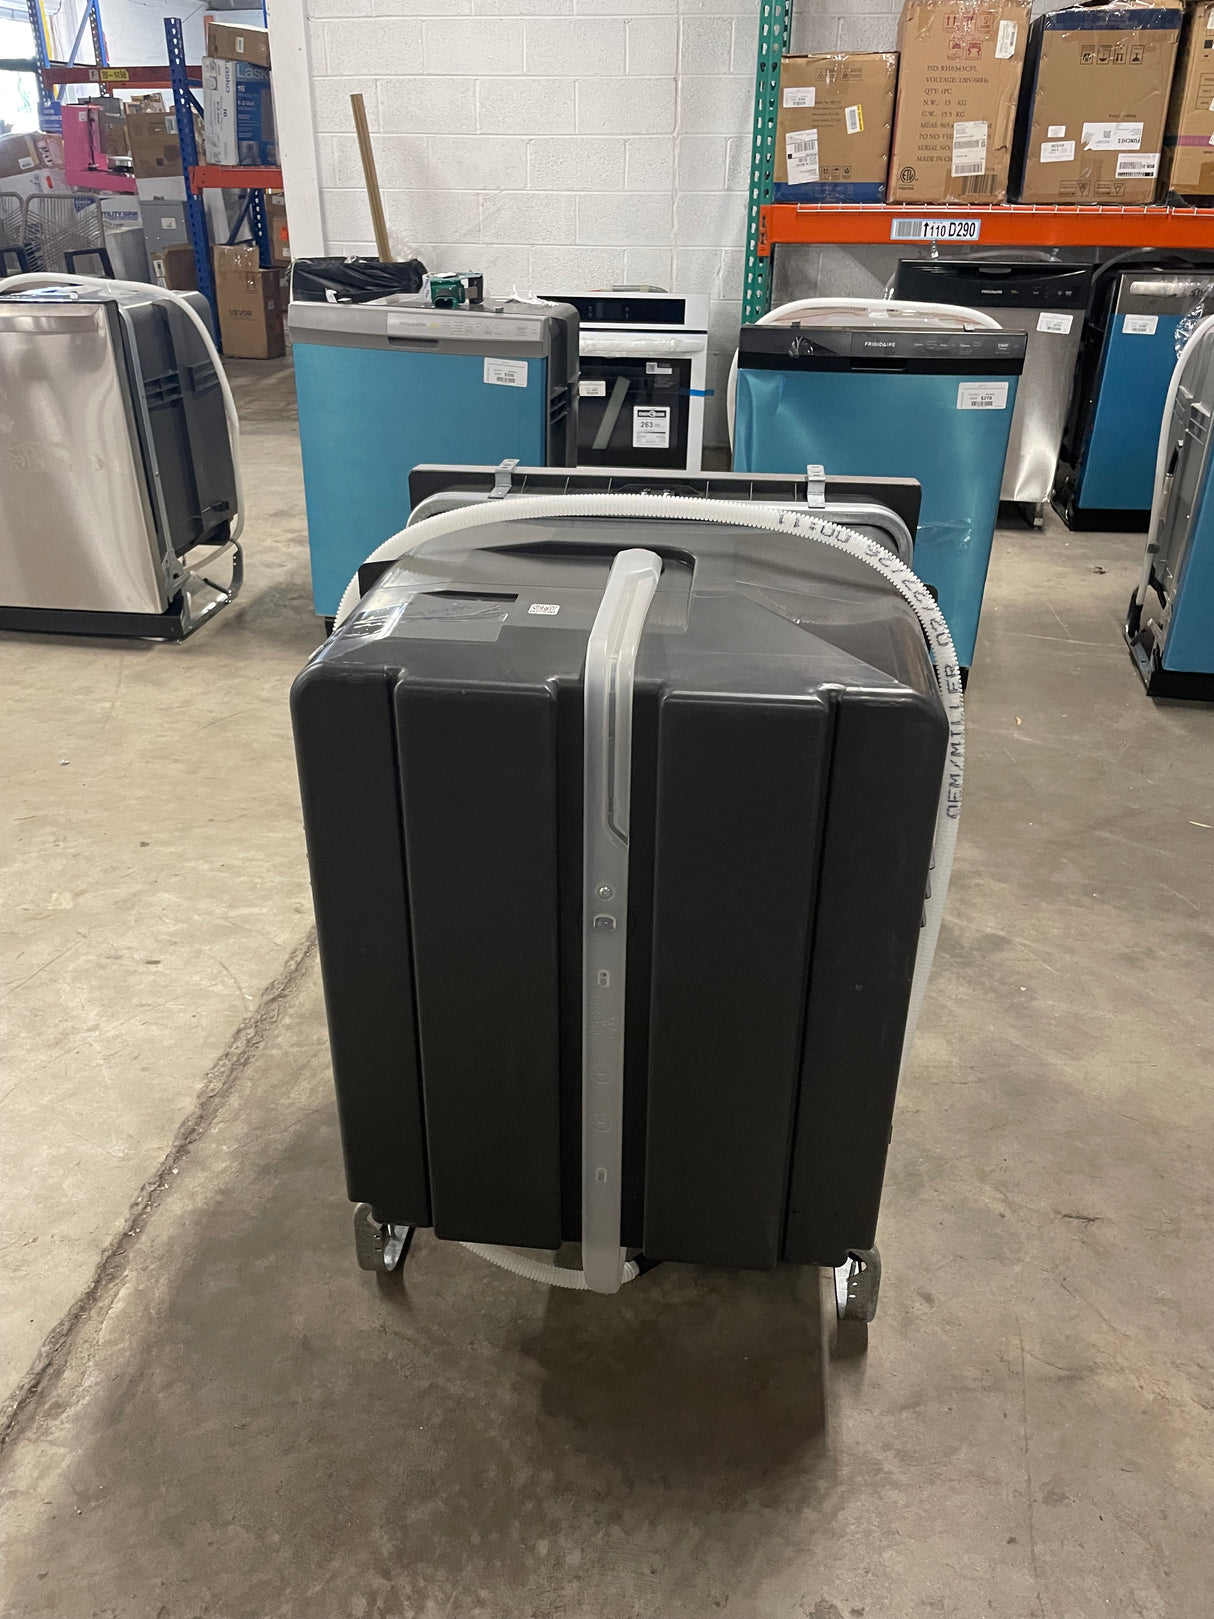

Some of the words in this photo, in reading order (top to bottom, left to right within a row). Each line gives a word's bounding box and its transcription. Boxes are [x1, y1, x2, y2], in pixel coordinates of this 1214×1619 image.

[930, 225, 946, 237] 110
[948, 222, 976, 237] D290
[640, 421, 654, 429] 263
